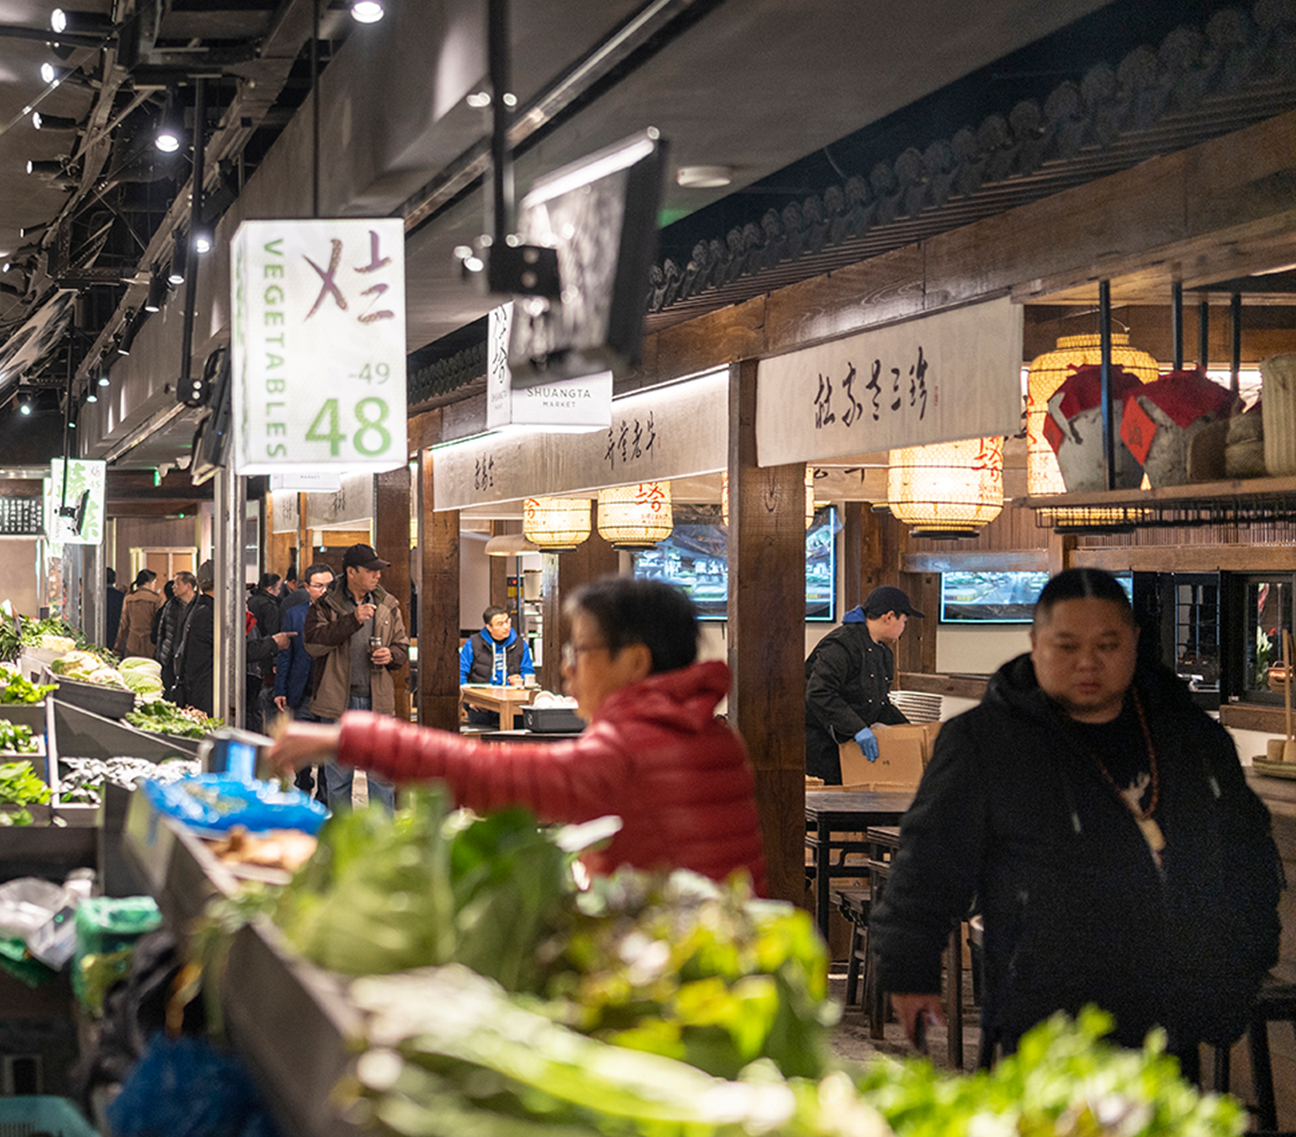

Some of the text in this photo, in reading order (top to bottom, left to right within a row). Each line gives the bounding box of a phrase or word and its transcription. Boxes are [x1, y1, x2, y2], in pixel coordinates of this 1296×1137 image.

[263, 238, 287, 458] VEGETABLES
[349, 362, 390, 385] -49
[527, 388, 591, 398] SHUANGTA
[304, 396, 392, 457] 48
